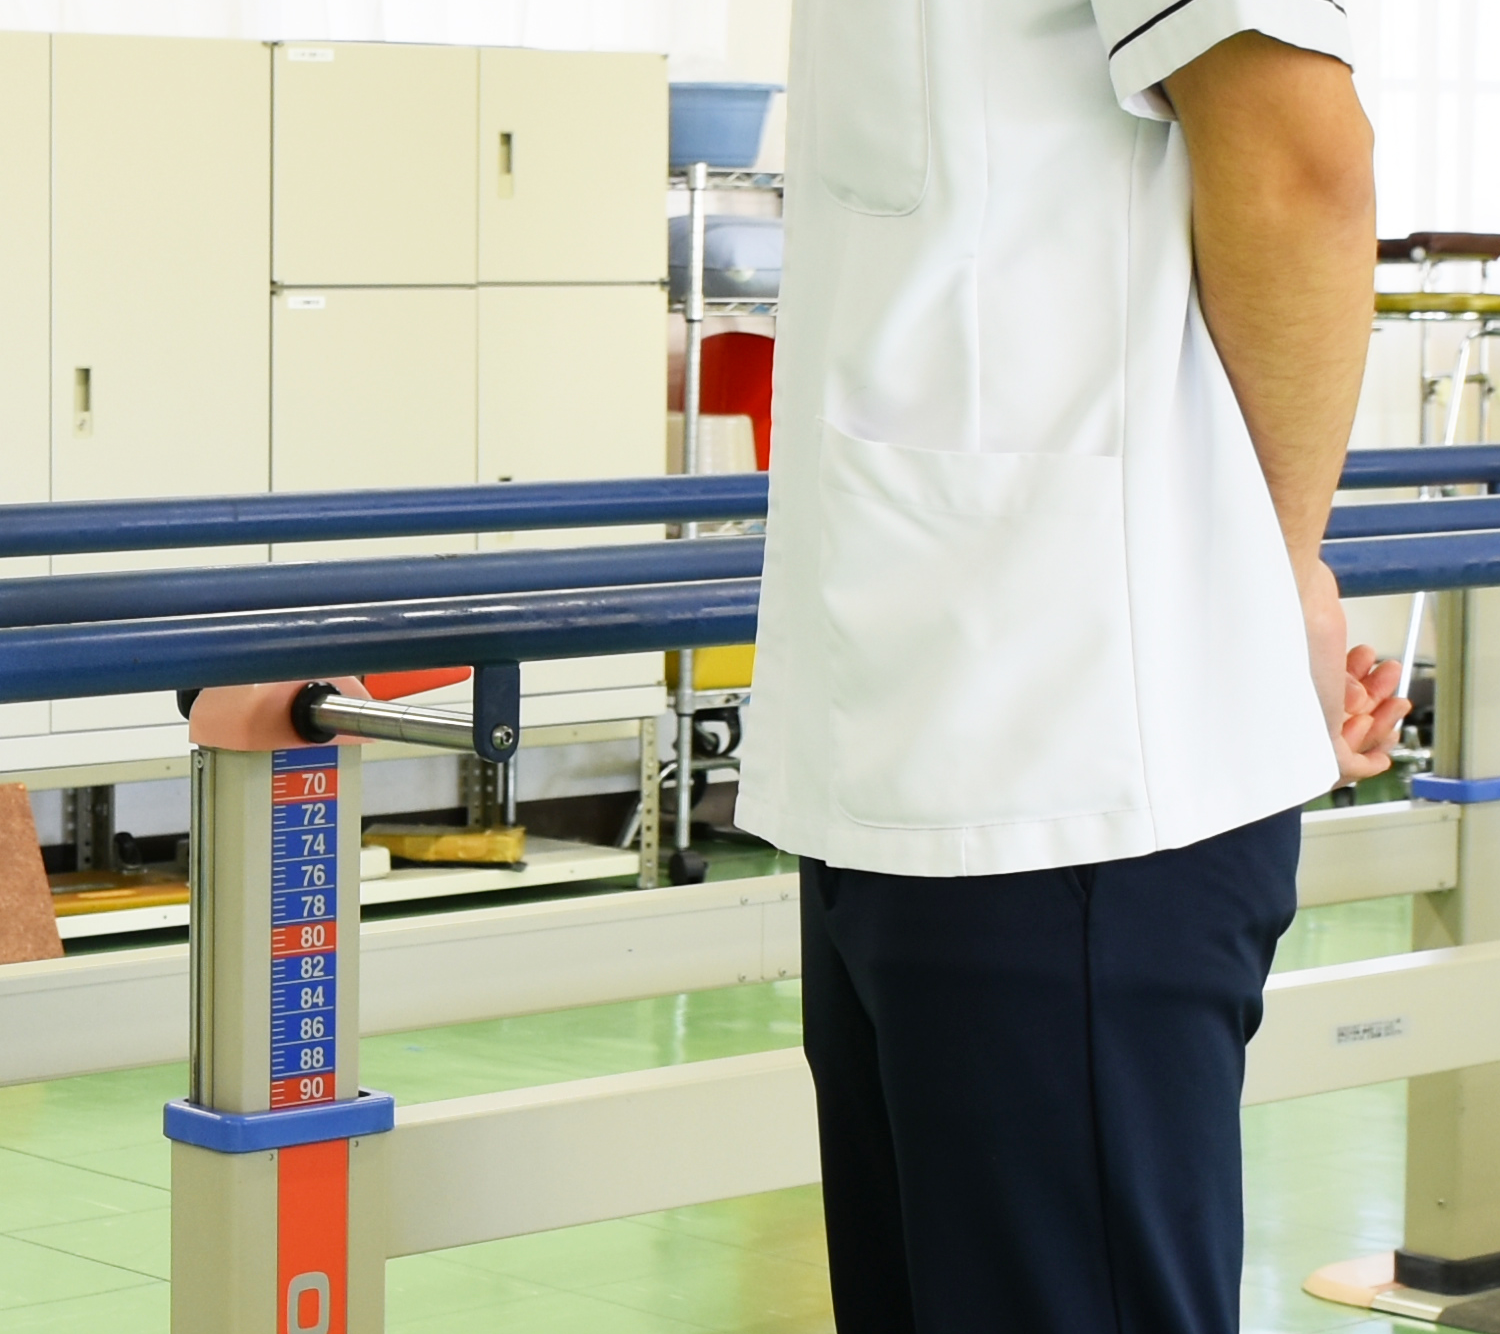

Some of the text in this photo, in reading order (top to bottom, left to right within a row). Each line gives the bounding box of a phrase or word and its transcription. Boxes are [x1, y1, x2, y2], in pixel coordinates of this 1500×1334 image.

[302, 772, 326, 796] 70
[302, 803, 326, 827] 72
[302, 833, 326, 857] 74
[301, 864, 326, 888] 76
[301, 894, 325, 918] 78
[301, 925, 325, 949] 80
[301, 955, 325, 979] 82
[301, 985, 324, 1009] 84
[301, 1016, 324, 1040] 86
[301, 1047, 324, 1071] 88
[300, 1077, 324, 1101] 90
